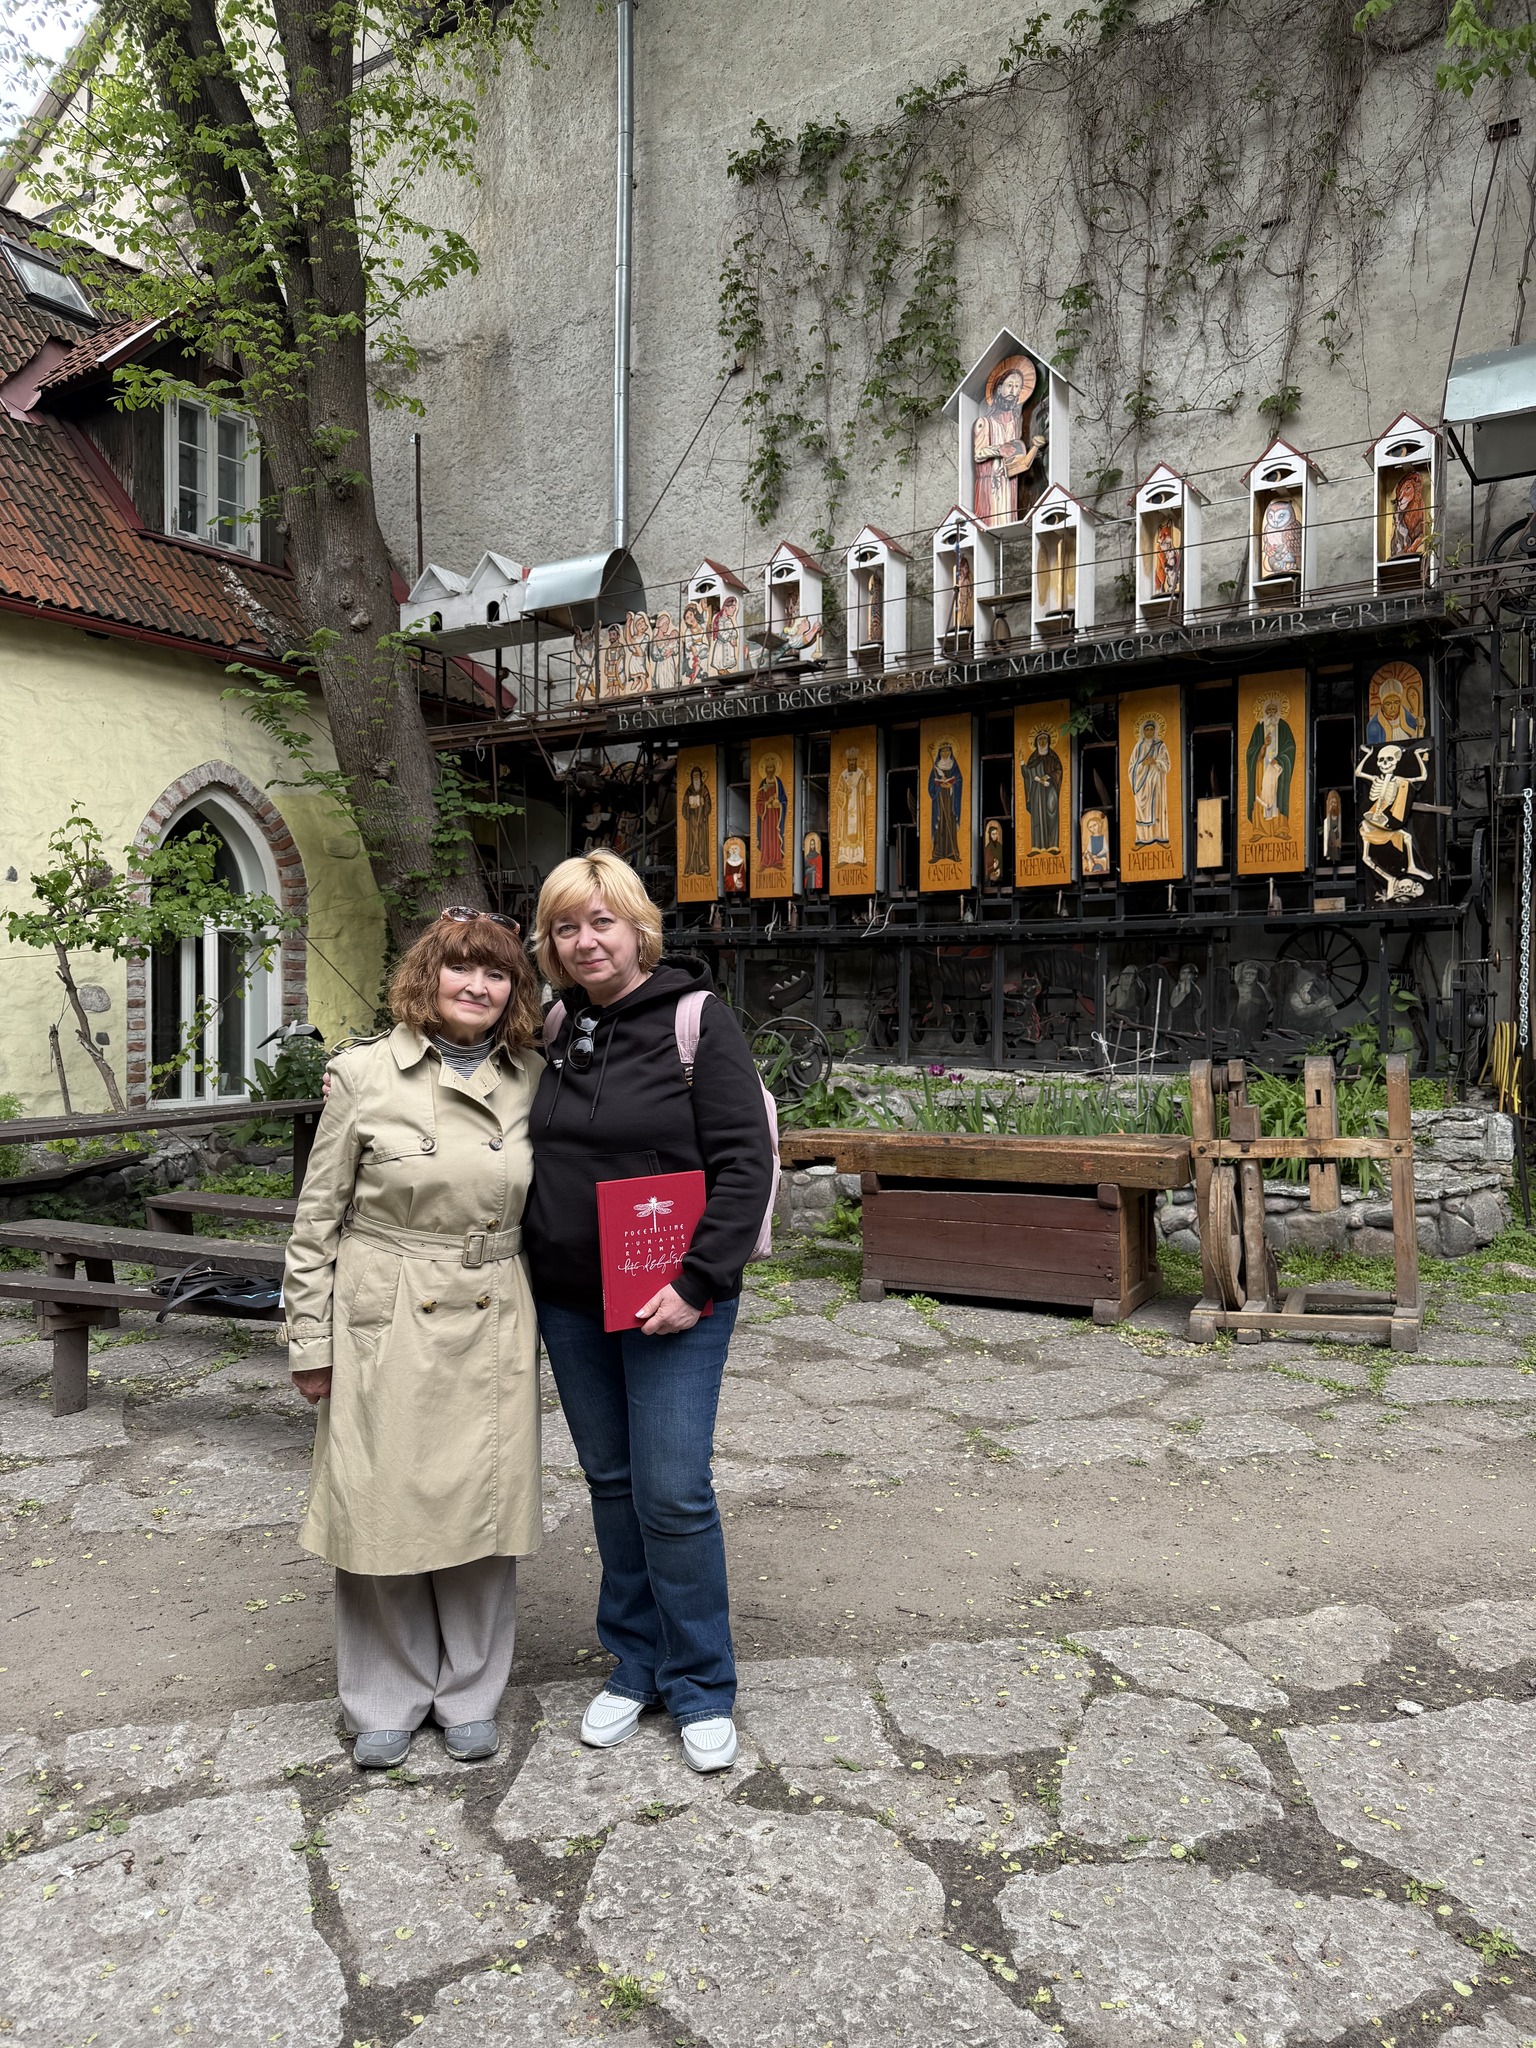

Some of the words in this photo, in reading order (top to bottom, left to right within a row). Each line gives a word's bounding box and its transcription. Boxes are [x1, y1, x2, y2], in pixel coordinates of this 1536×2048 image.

[618, 707, 673, 731] BENE
[684, 695, 768, 722] MERENTI
[778, 685, 832, 711] BENE
[1006, 646, 1079, 677] MALE
[1092, 622, 1221, 665] MERENTI
[1250, 612, 1313, 641] PAR
[1327, 596, 1418, 630] ERIT
[624, 1223, 685, 1237] POEETILINE
[625, 1242, 687, 1257] RAAMAT
